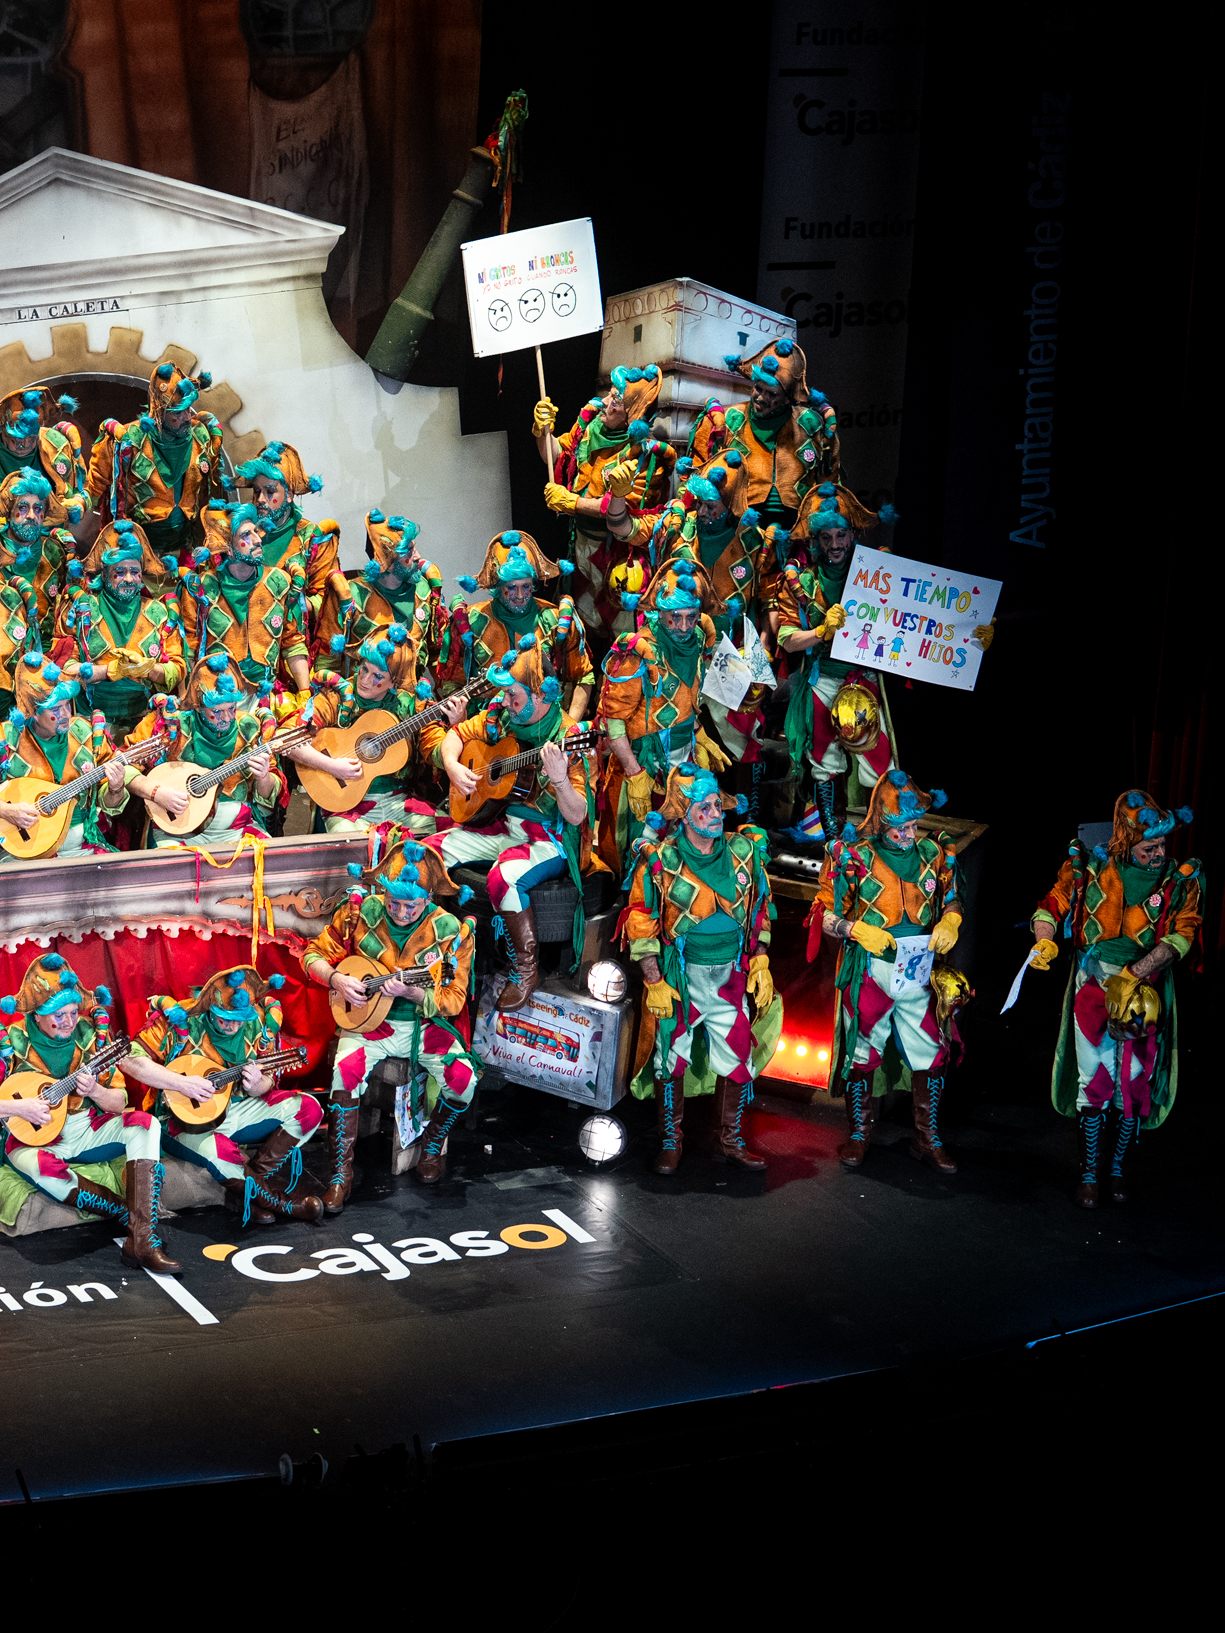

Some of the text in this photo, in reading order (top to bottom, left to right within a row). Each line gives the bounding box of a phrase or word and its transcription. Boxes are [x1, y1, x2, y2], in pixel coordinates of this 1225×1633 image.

[489, 265, 516, 281] GRITOS
[540, 251, 574, 269] BRONCAS
[527, 270, 552, 281] CUANDO
[17, 299, 120, 320] LA CALETA
[1009, 88, 1072, 549] Ayuntamiento de Cádiz
[853, 566, 892, 595] MÁS
[844, 599, 955, 641] CON VUESTROS
[569, 1012, 591, 1028] Cádiz
[516, 1052, 525, 1065] el
[528, 1055, 583, 1078] Carnaval!
[231, 1208, 598, 1282] Cajasol
